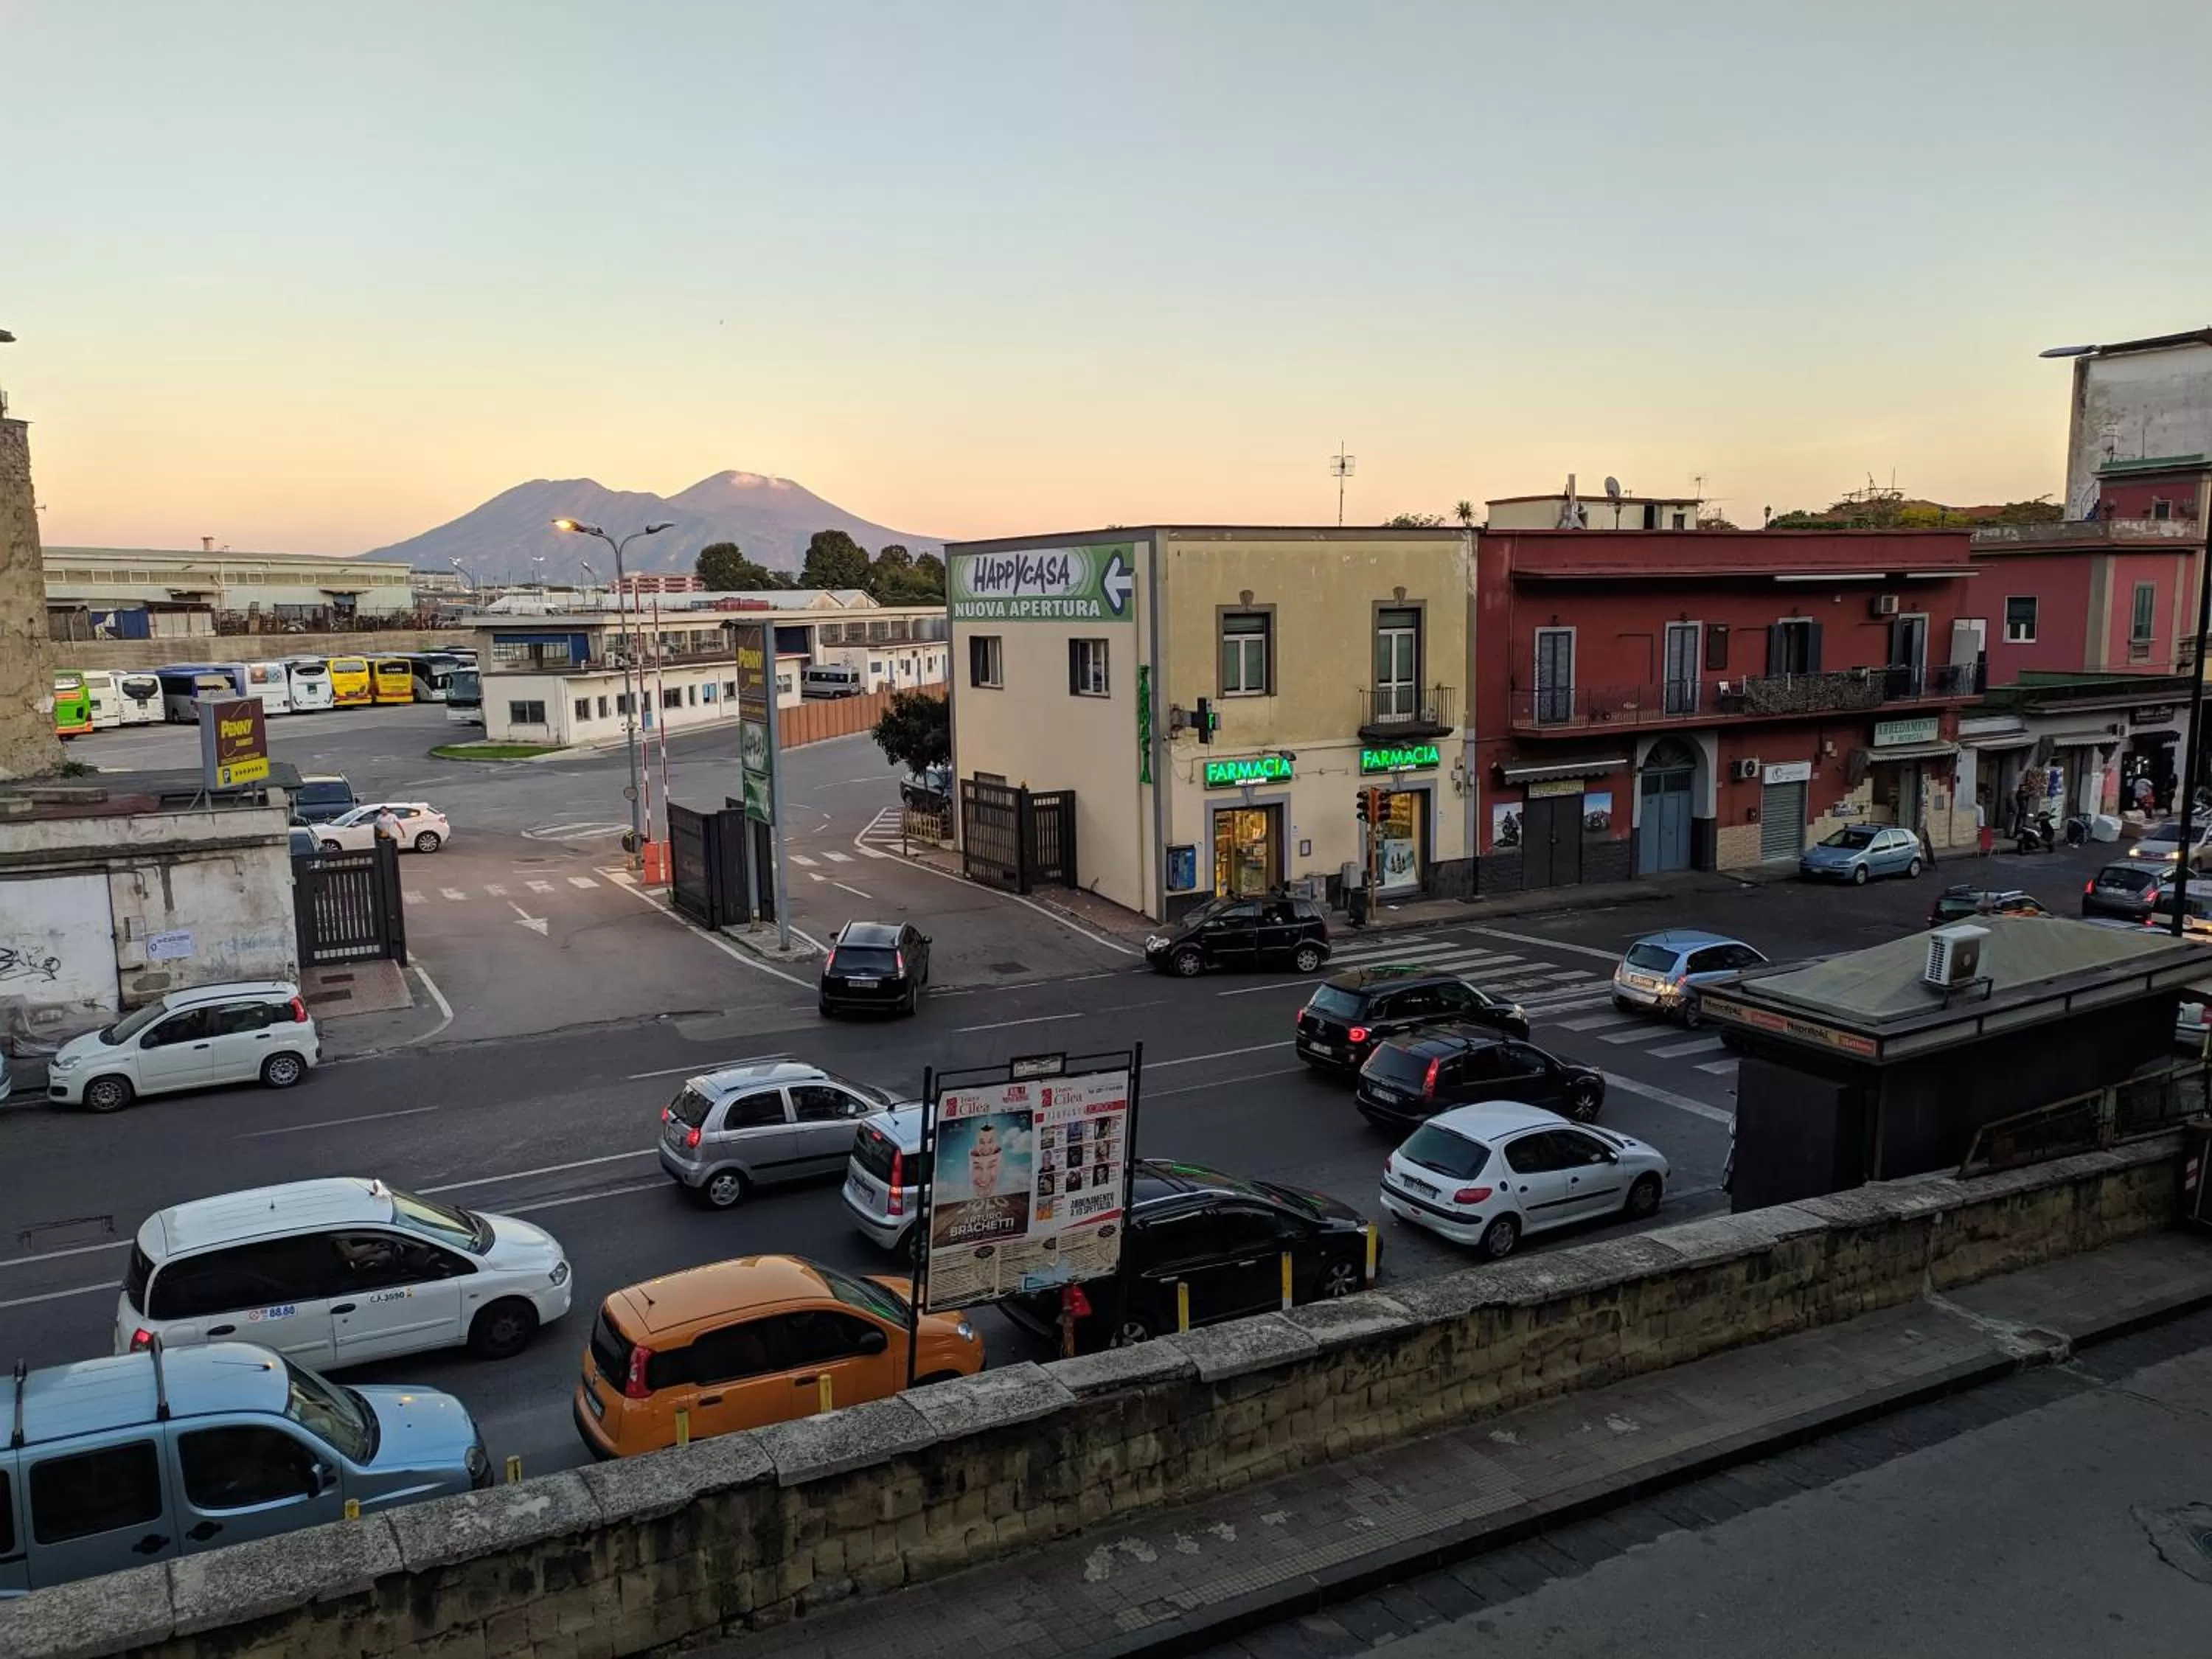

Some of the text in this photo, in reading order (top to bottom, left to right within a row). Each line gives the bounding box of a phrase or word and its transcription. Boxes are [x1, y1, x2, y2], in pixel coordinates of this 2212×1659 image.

[954, 599, 1101, 617] NUOVA APERTURA
[220, 718, 254, 739] PENNY
[1363, 746, 1439, 768] FARMACIA
[1207, 759, 1292, 782] FARMACIA
[1054, 1092, 1083, 1105] Cilea
[959, 1102, 990, 1116] Cilea
[950, 1217, 1015, 1237] BRACHETTI
[964, 1211, 1003, 1225] ARTURO
